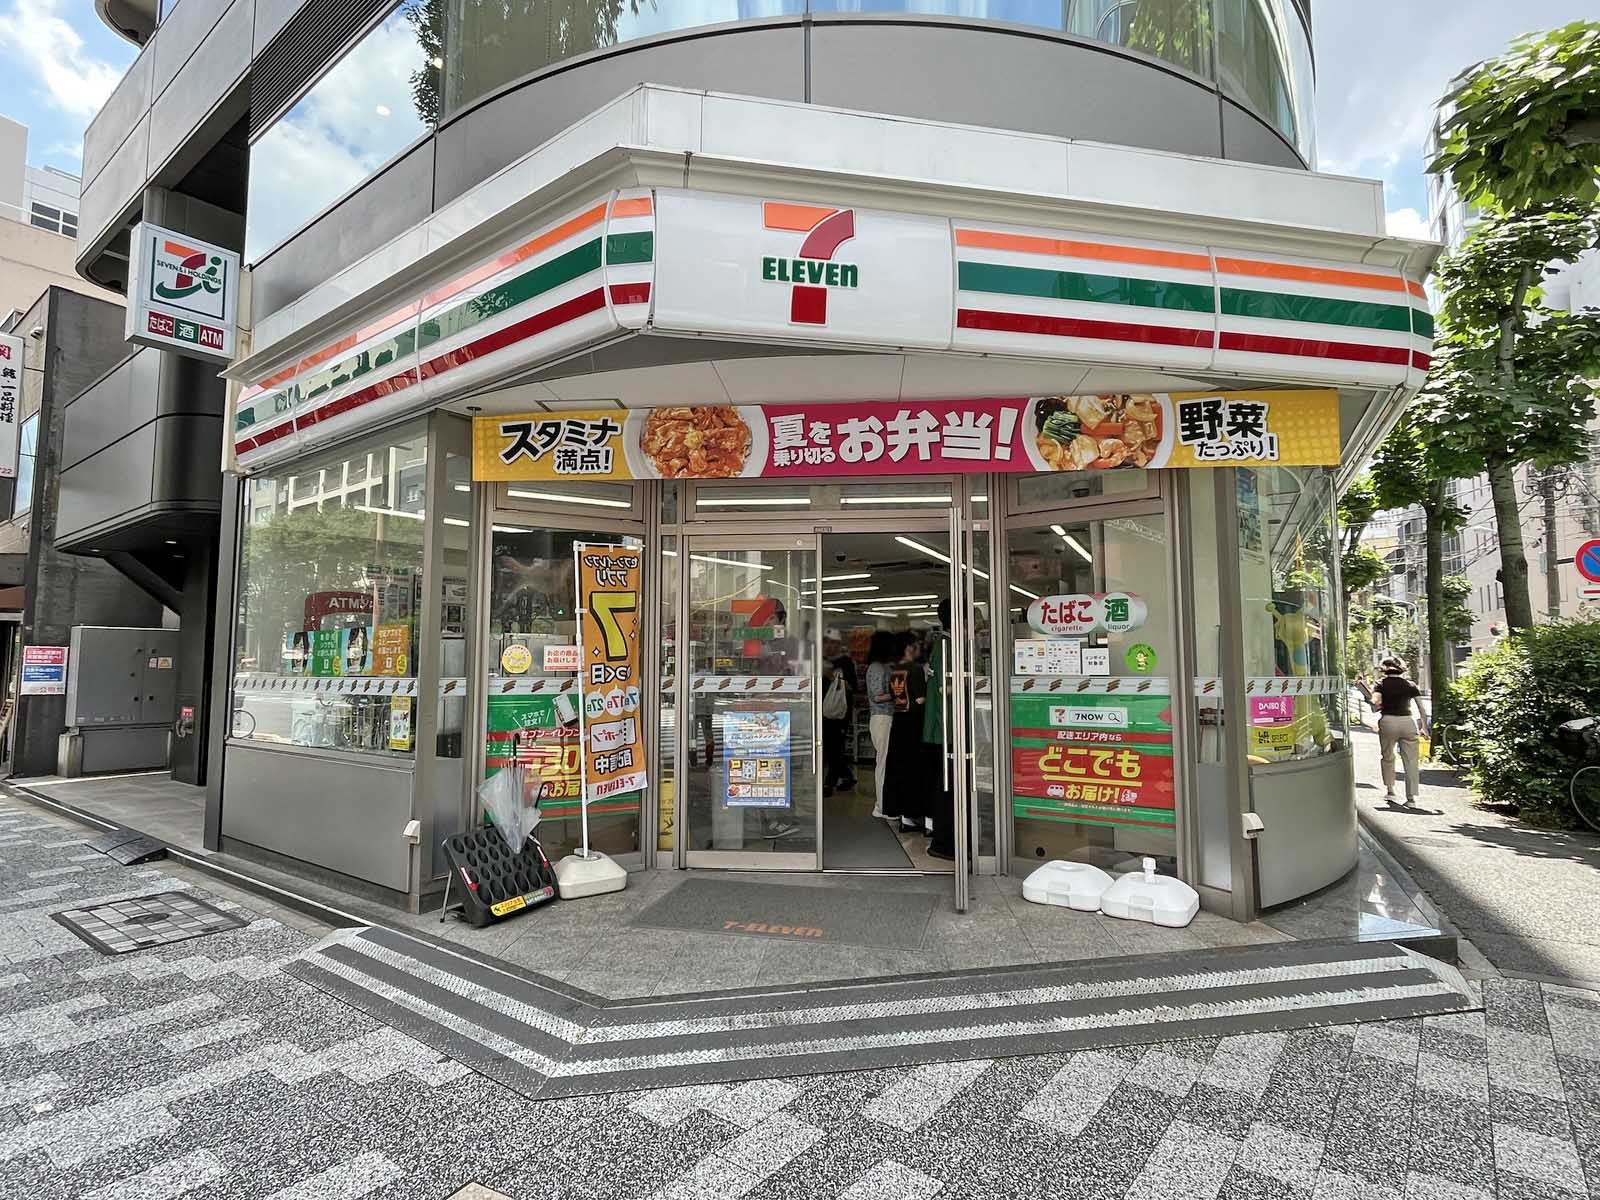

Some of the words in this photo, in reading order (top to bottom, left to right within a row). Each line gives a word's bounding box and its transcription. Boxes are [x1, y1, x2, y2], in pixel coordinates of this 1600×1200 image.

[149, 316, 173, 333] たばこ
[179, 323, 194, 339] 酒
[201, 330, 222, 346] ATM
[1180, 400, 1266, 442] 野菜
[501, 418, 619, 461] スタミナ
[770, 414, 832, 450] 夏を
[773, 448, 836, 467] 乗り切る
[1041, 600, 1094, 625] たばこ
[1105, 598, 1129, 622] 酒
[1108, 623, 1130, 631] liquor
[1258, 702, 1280, 710] DAISO
[1038, 744, 1142, 778] どこでも
